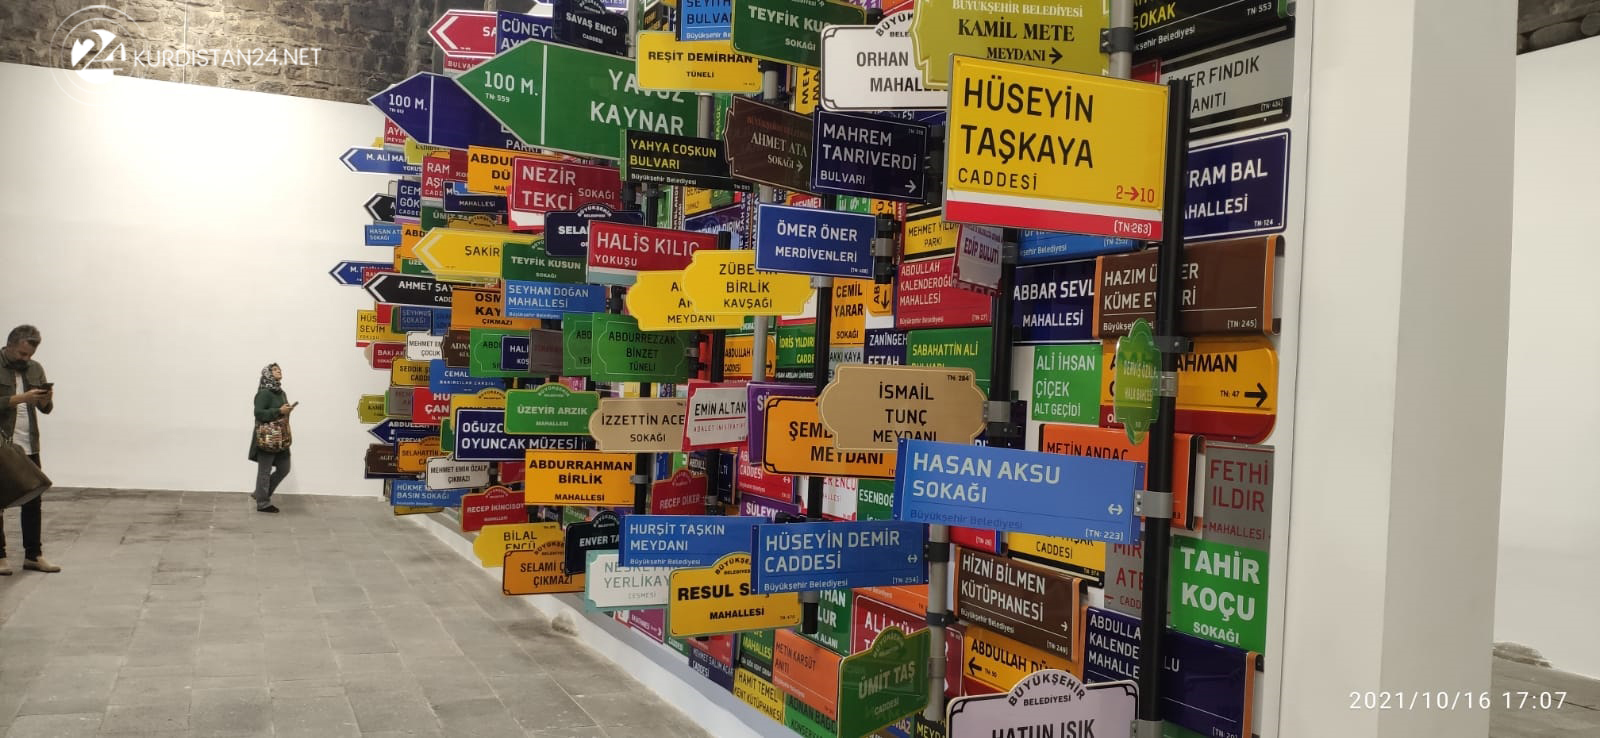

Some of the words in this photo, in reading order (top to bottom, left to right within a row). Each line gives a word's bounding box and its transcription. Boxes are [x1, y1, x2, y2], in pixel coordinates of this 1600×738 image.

[748, 5, 799, 28] TEYFİK
[1022, 3, 1083, 17] BELEDİYESİ
[566, 12, 593, 29] SAVAŞ
[595, 22, 618, 37] ENCÜ
[958, 16, 1018, 39] KAMİL
[1023, 23, 1075, 42] METE
[1158, 24, 1196, 43] Belediyesi
[784, 36, 816, 51] SOKAĞI
[648, 51, 684, 65] REŞİT
[687, 50, 753, 65] DEMİRHAN
[857, 52, 909, 67] ORHAN
[986, 47, 1046, 62] MEYDANI
[1209, 56, 1260, 83] FINDIK
[484, 70, 515, 92] 100
[520, 78, 539, 97] M.
[388, 93, 411, 108] 100
[414, 96, 428, 111] M.
[964, 75, 1094, 123] HÜSEYİN
[1192, 92, 1226, 113] ANITI
[590, 101, 684, 137] KAYNAR
[823, 122, 893, 147] MAHREM
[630, 139, 670, 153] YAHYA
[672, 143, 717, 159] COŞKUN
[750, 132, 788, 152] AHMET
[790, 142, 808, 159] ATA
[961, 124, 1093, 168] TAŞKAYA
[377, 153, 392, 165] ALİ
[630, 155, 680, 170] BULVARI
[767, 153, 795, 170] SOKAĞI
[822, 143, 917, 171] TANRIVERDİ
[522, 165, 576, 187] NEZİR
[820, 170, 866, 185] BULVARI
[1231, 158, 1269, 184] BAL
[631, 173, 666, 184] Büyükşehir
[667, 175, 697, 187] Belediyesi
[958, 168, 1038, 190] CADDESİ
[521, 190, 573, 212] TEKÇİ
[578, 187, 615, 200] SOKAĞI
[777, 219, 818, 239] ÖMER
[820, 222, 858, 243] ÖNER
[908, 223, 937, 236] MEHMET
[597, 232, 650, 253] HALİS
[924, 238, 943, 248] PARKI
[595, 254, 638, 269] YOKUŞU
[775, 245, 858, 264] MERDİVENLERİ
[511, 255, 547, 267] TEYFİK
[548, 259, 581, 270] KUSUN
[901, 262, 941, 277] ABDULLAH
[1104, 268, 1146, 288] HAZIM
[398, 281, 432, 292] AHMET
[508, 285, 552, 297] SEYHAN
[553, 285, 589, 299] DOĞAN
[726, 280, 770, 293] BİRLİK
[836, 283, 863, 299] CEMİL
[1013, 282, 1057, 302] ABBAR
[508, 297, 569, 308] MAHALLESİ
[724, 297, 773, 310] KAVŞAĞI
[900, 292, 941, 307] MAHALLESİ
[1104, 290, 1141, 311] KÜME
[834, 303, 864, 318] YARAR
[1022, 308, 1084, 328] MAHALLESİ
[482, 318, 513, 327] ÇIKMAZI
[667, 314, 716, 325] MEYDANI
[360, 324, 386, 335] SEVİM
[836, 330, 859, 340] SOKAĞI
[609, 331, 677, 346] ABDURREZZAK
[626, 347, 660, 360] BİNZET
[724, 349, 752, 361] ABDULLAH
[844, 351, 862, 362] KAYA
[912, 342, 963, 357] SABAHATTİN
[963, 341, 979, 357] ALİ
[629, 360, 657, 373] TÜNELİ
[1036, 353, 1056, 371] ALİ
[1057, 352, 1096, 371] İHSAN
[444, 370, 469, 379] CEMAL
[879, 382, 935, 402] İSMAİL
[1035, 379, 1070, 399] ÇİÇEK
[517, 404, 555, 416] ÜZEYİR
[557, 407, 588, 416] ARZIK
[719, 401, 747, 415] ALTAN
[1034, 403, 1050, 416] ALT
[1050, 402, 1081, 419] GEÇİDİ
[602, 413, 660, 426] İZZETTİN
[885, 408, 928, 428] TUNÇ
[461, 437, 526, 451] OYUNCAK
[529, 436, 578, 451] MÜZESİ
[630, 433, 666, 444] SOKAĞI
[872, 430, 937, 445] MEYDANI
[528, 459, 633, 472] ABDURRAHMAN
[913, 452, 991, 478] HASAN
[997, 461, 1061, 485] AKSU
[1210, 458, 1269, 486] FETHİ
[558, 472, 603, 486] BİRLİK
[397, 491, 421, 500] BASIN
[422, 490, 450, 500] SOKAĞI
[554, 493, 605, 502] MAHALLESİ
[913, 479, 987, 504] SOKAĞI
[660, 499, 681, 511] RECEP
[1212, 486, 1265, 513] ILDIR
[466, 504, 490, 514] RECEP
[503, 529, 538, 542] BİLAL
[630, 523, 678, 538] HURŞİT
[680, 523, 726, 538] TAŞKIN
[1209, 521, 1265, 541] MAHALLESİ
[579, 535, 608, 547] ENVER
[630, 539, 689, 552] MEYDANI
[765, 529, 843, 552] HÜSEYİN
[847, 528, 900, 548] DEMİR
[1036, 541, 1073, 560] CADDESİ
[520, 560, 557, 573] SELAMİ
[630, 557, 666, 567] Büyükşehir
[667, 557, 701, 566] Belediyesi
[764, 551, 841, 573] CADDESİ
[1180, 546, 1261, 588] TAHİR
[533, 575, 573, 588] ÇIKMAZI
[962, 553, 994, 580] HİZNİ
[996, 561, 1047, 596] BİLMEN
[677, 584, 734, 602] RESUL
[763, 581, 808, 594] Büyükşehir
[809, 579, 848, 591] Belediyesi
[961, 579, 1044, 623] KÜTÜPHANESİ
[1181, 582, 1256, 622] KOÇU
[709, 607, 765, 620] MAHALLESİ
[1193, 621, 1240, 645] SOKAĞI
[775, 641, 792, 658] METİN
[971, 639, 1028, 672] ABDULLAH
[738, 671, 757, 690] HAMİT
[757, 679, 778, 703] TEMEL
[858, 668, 891, 700] ÜMİT
[893, 660, 916, 685] TAŞ
[1008, 673, 1086, 706] BÜYÜKŞEHİR
[1023, 694, 1072, 707] BELEDİYESİ
